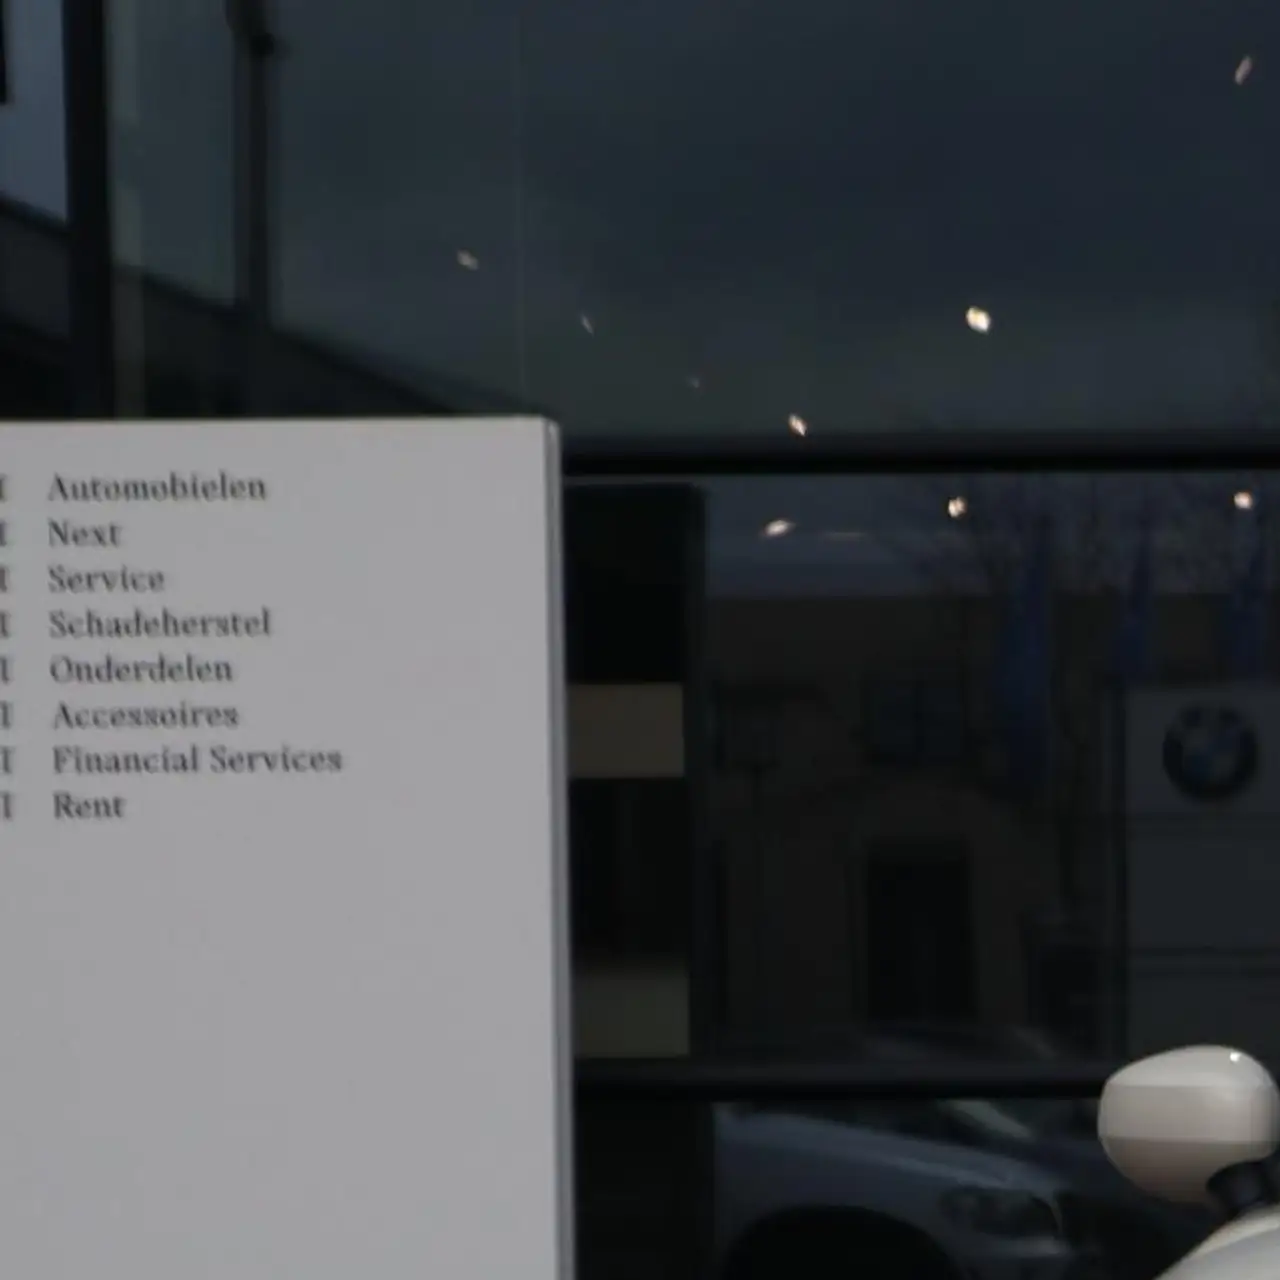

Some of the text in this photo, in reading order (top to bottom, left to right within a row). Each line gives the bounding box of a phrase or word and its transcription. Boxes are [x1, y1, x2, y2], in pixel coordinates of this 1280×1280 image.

[48, 471, 268, 502] Automobielen
[47, 519, 121, 548] Next
[47, 564, 166, 594] Service
[48, 606, 272, 639] Schadeherstel
[49, 652, 234, 684] Onderdelen
[53, 701, 240, 731] Accessoires
[52, 743, 200, 775] Financial
[209, 744, 343, 774] Services
[53, 791, 126, 820] Rent
